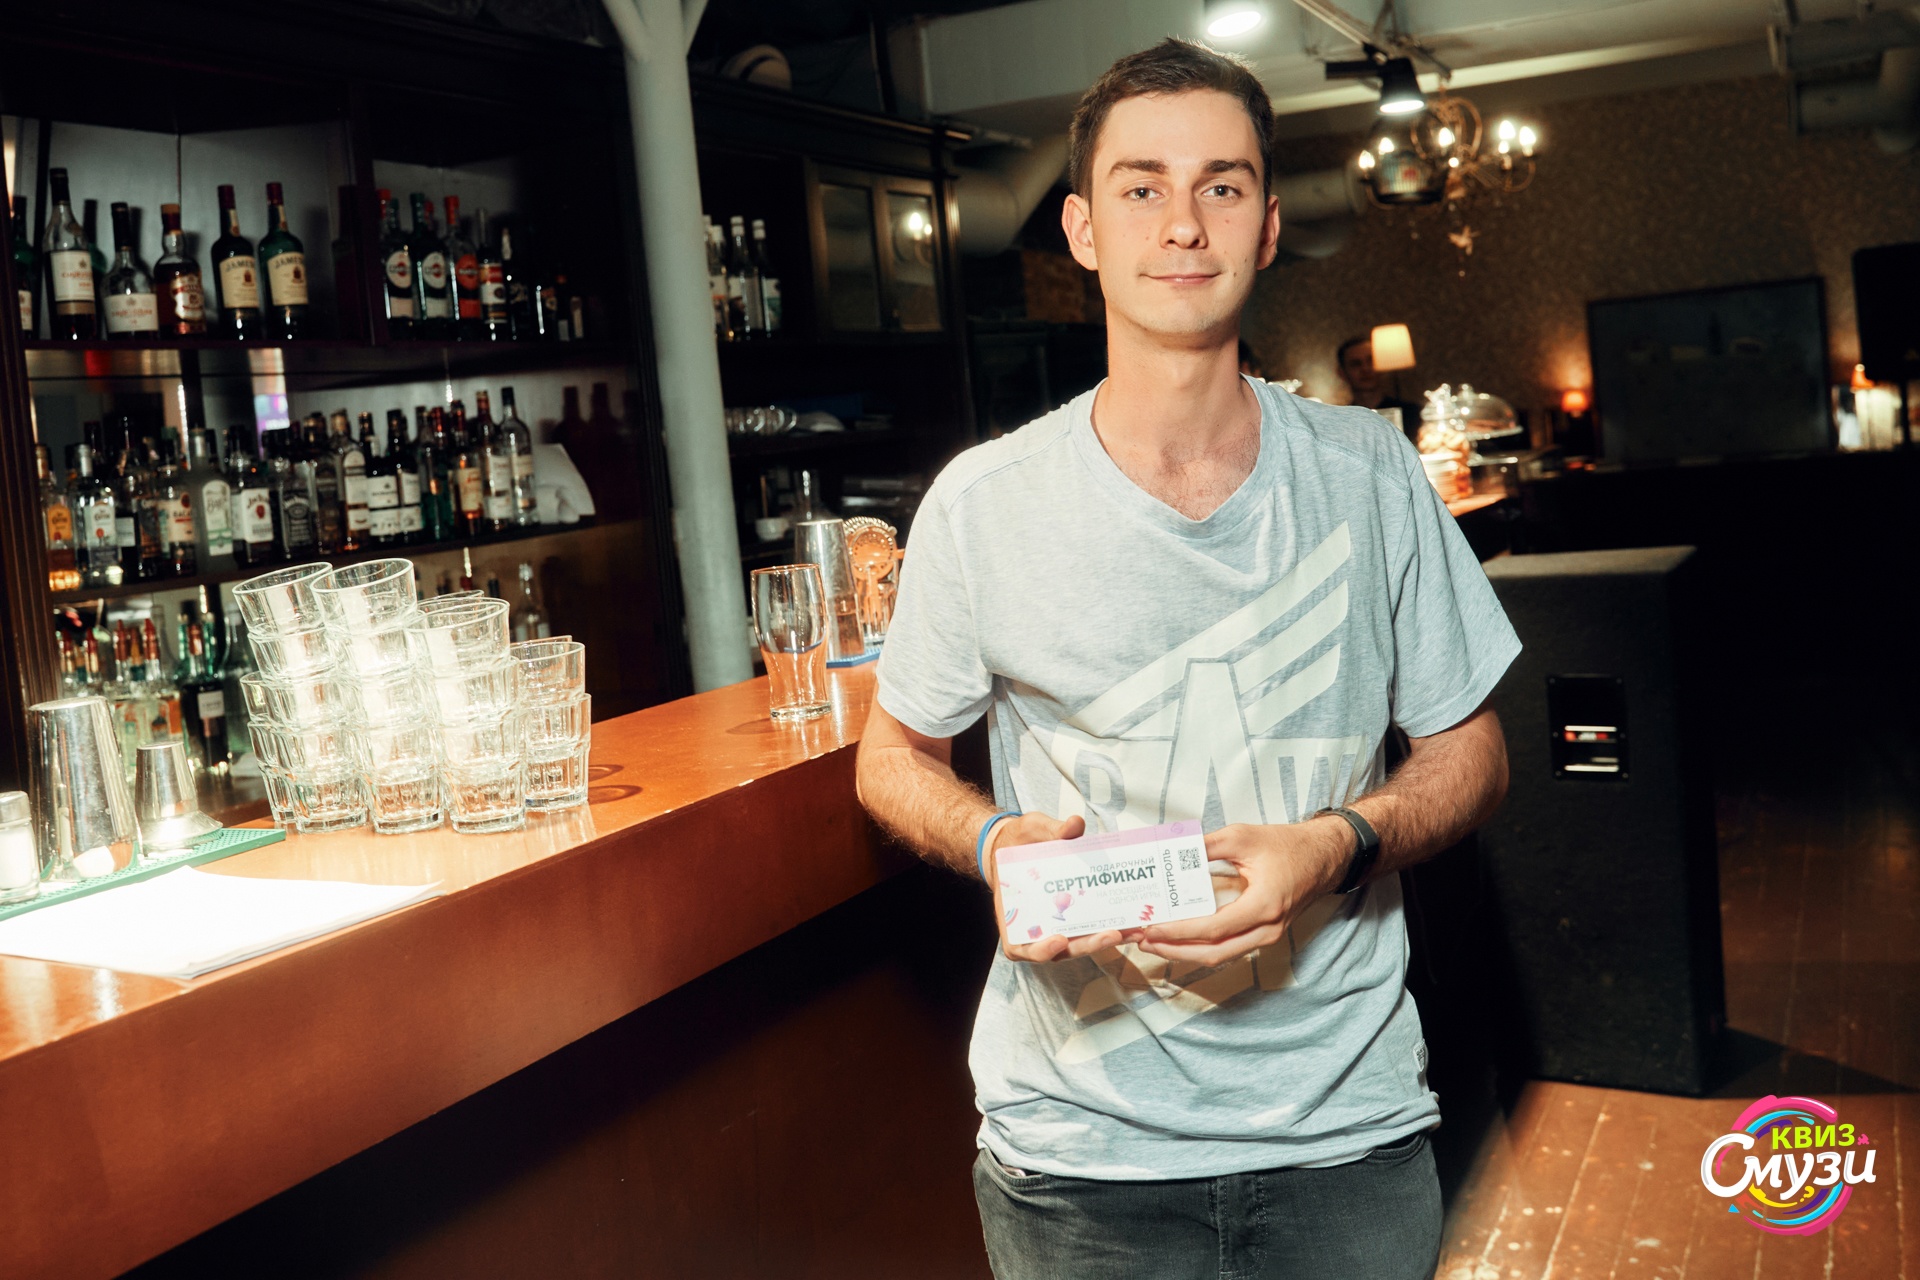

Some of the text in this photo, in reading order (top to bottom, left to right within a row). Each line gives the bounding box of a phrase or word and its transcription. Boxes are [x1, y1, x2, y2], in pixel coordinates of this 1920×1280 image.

[1089, 856, 1155, 873] ПОДАРОЧНЫЙ
[1163, 848, 1180, 907] КОНТРОЛЬ
[1043, 865, 1156, 894] СЕРТИФИКАТ
